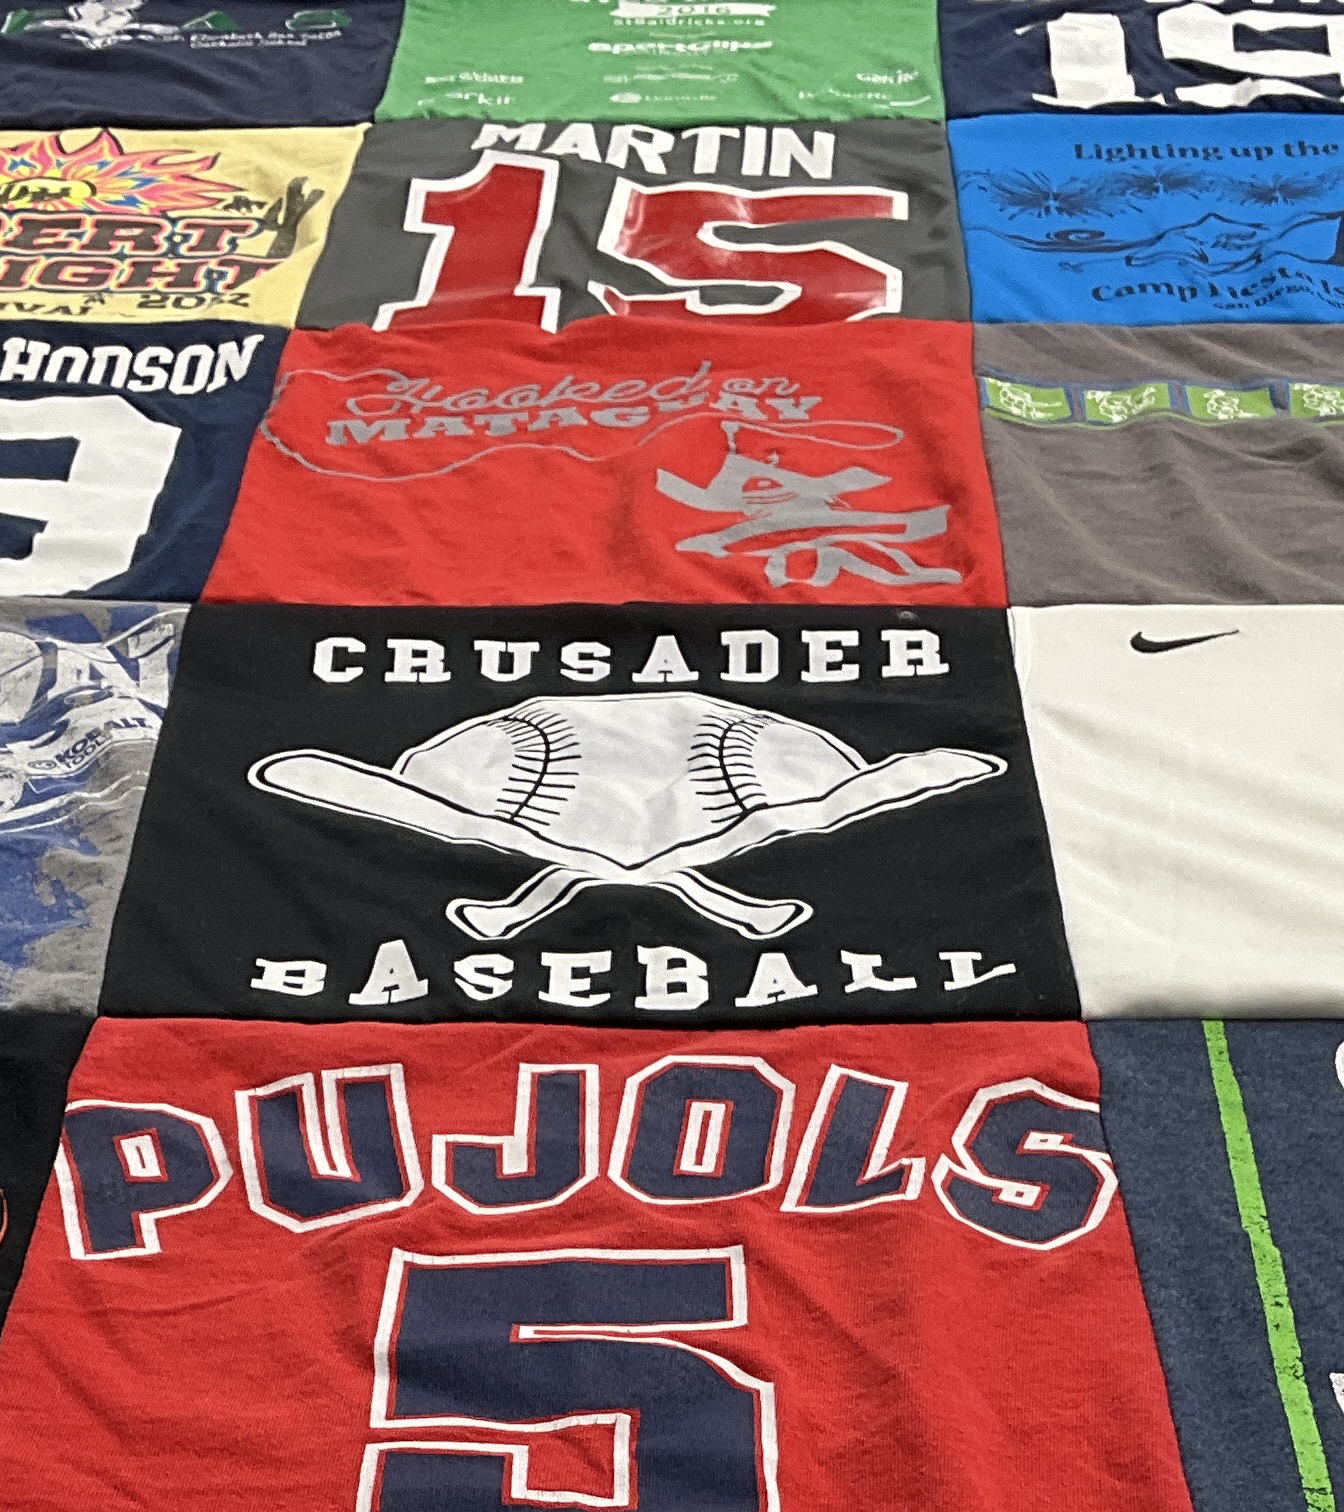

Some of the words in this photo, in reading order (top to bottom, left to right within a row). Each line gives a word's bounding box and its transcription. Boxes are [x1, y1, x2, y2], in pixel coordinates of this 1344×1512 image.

[472, 121, 835, 181] MARTIN
[1073, 141, 1223, 162] Lighting
[1231, 143, 1275, 162] up
[1282, 140, 1342, 159] the
[372, 149, 910, 332] 15
[1091, 280, 1199, 304] Camp
[346, 361, 712, 415] Hooked
[723, 375, 798, 398] on
[311, 628, 950, 684] CRUSADER
[249, 940, 1017, 1011] BASEBALL
[53, 1054, 1119, 1262] PUJOLS
